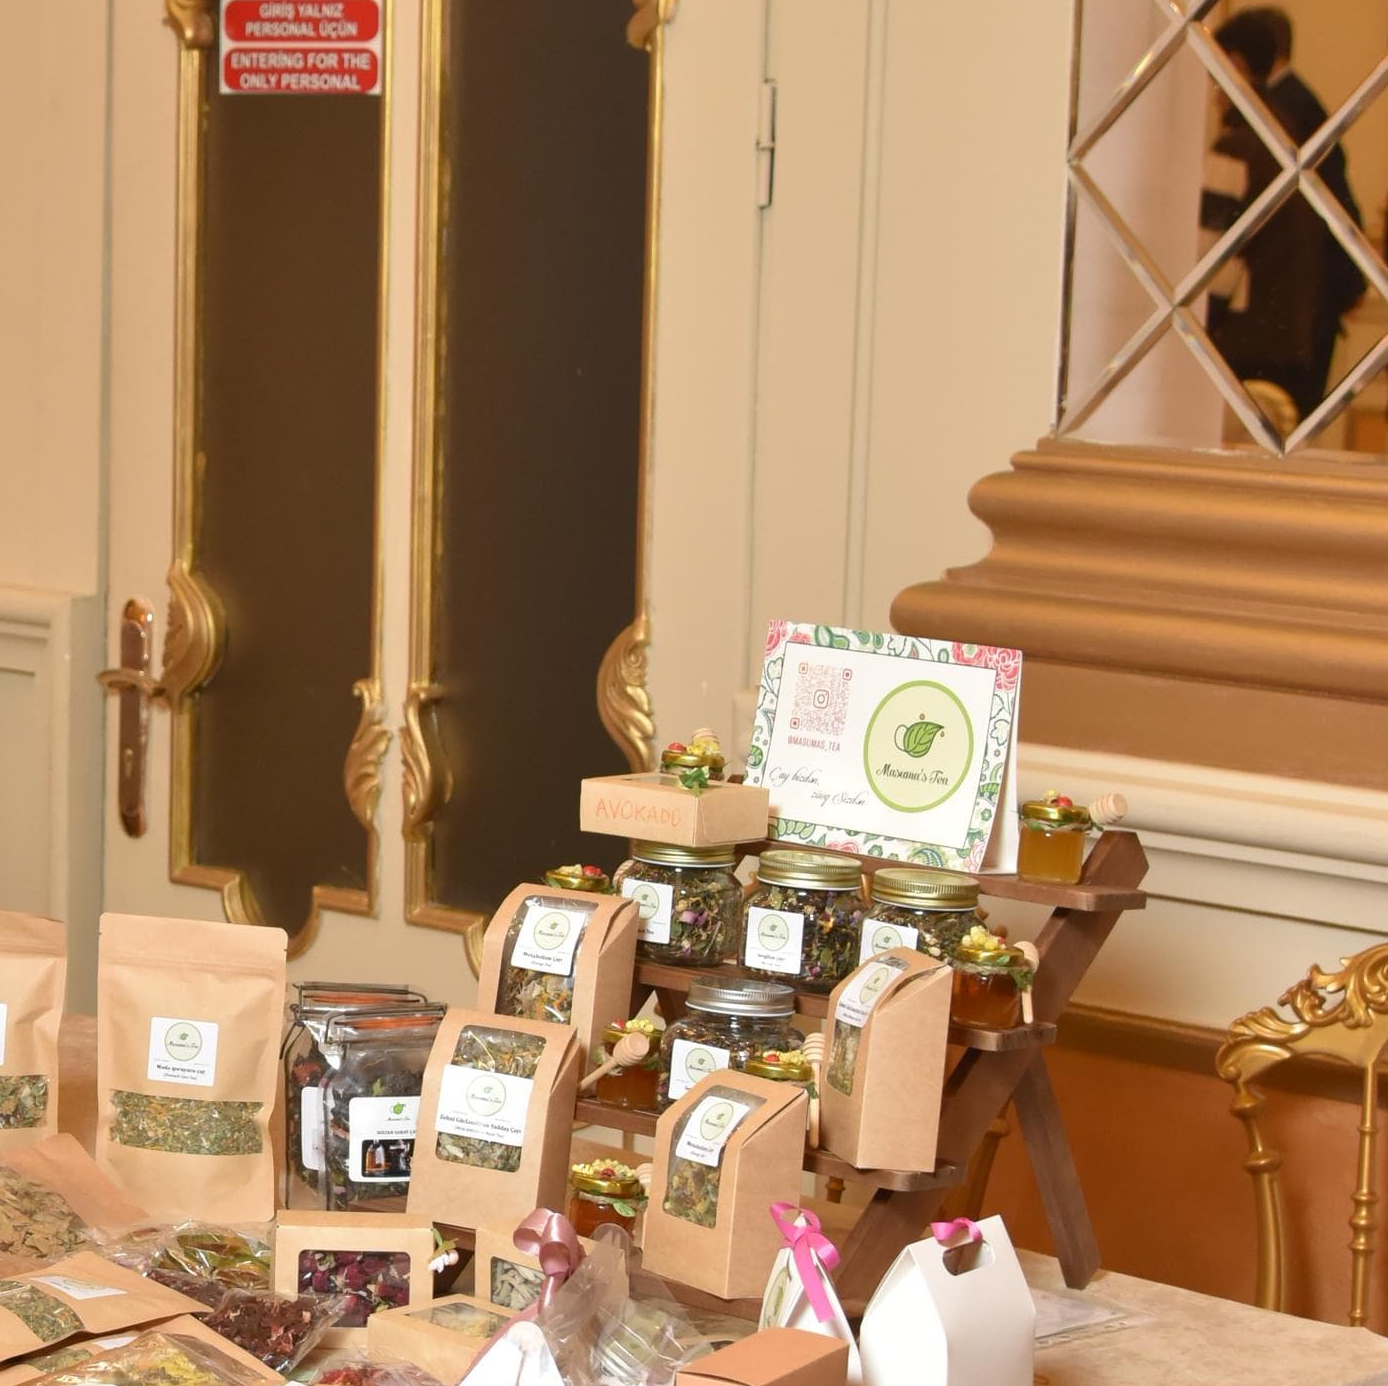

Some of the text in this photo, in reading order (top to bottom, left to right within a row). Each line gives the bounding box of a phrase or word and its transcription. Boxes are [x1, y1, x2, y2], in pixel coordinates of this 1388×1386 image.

[298, 3, 344, 18] YALNIZ
[245, 20, 357, 40] PERSONAL ÜÇÜN
[307, 53, 338, 68] FOR
[341, 53, 371, 69] THE
[240, 73, 360, 90] ONLY PERSONAL
[929, 770, 949, 785] Tea
[596, 798, 682, 828] AVOKADO
